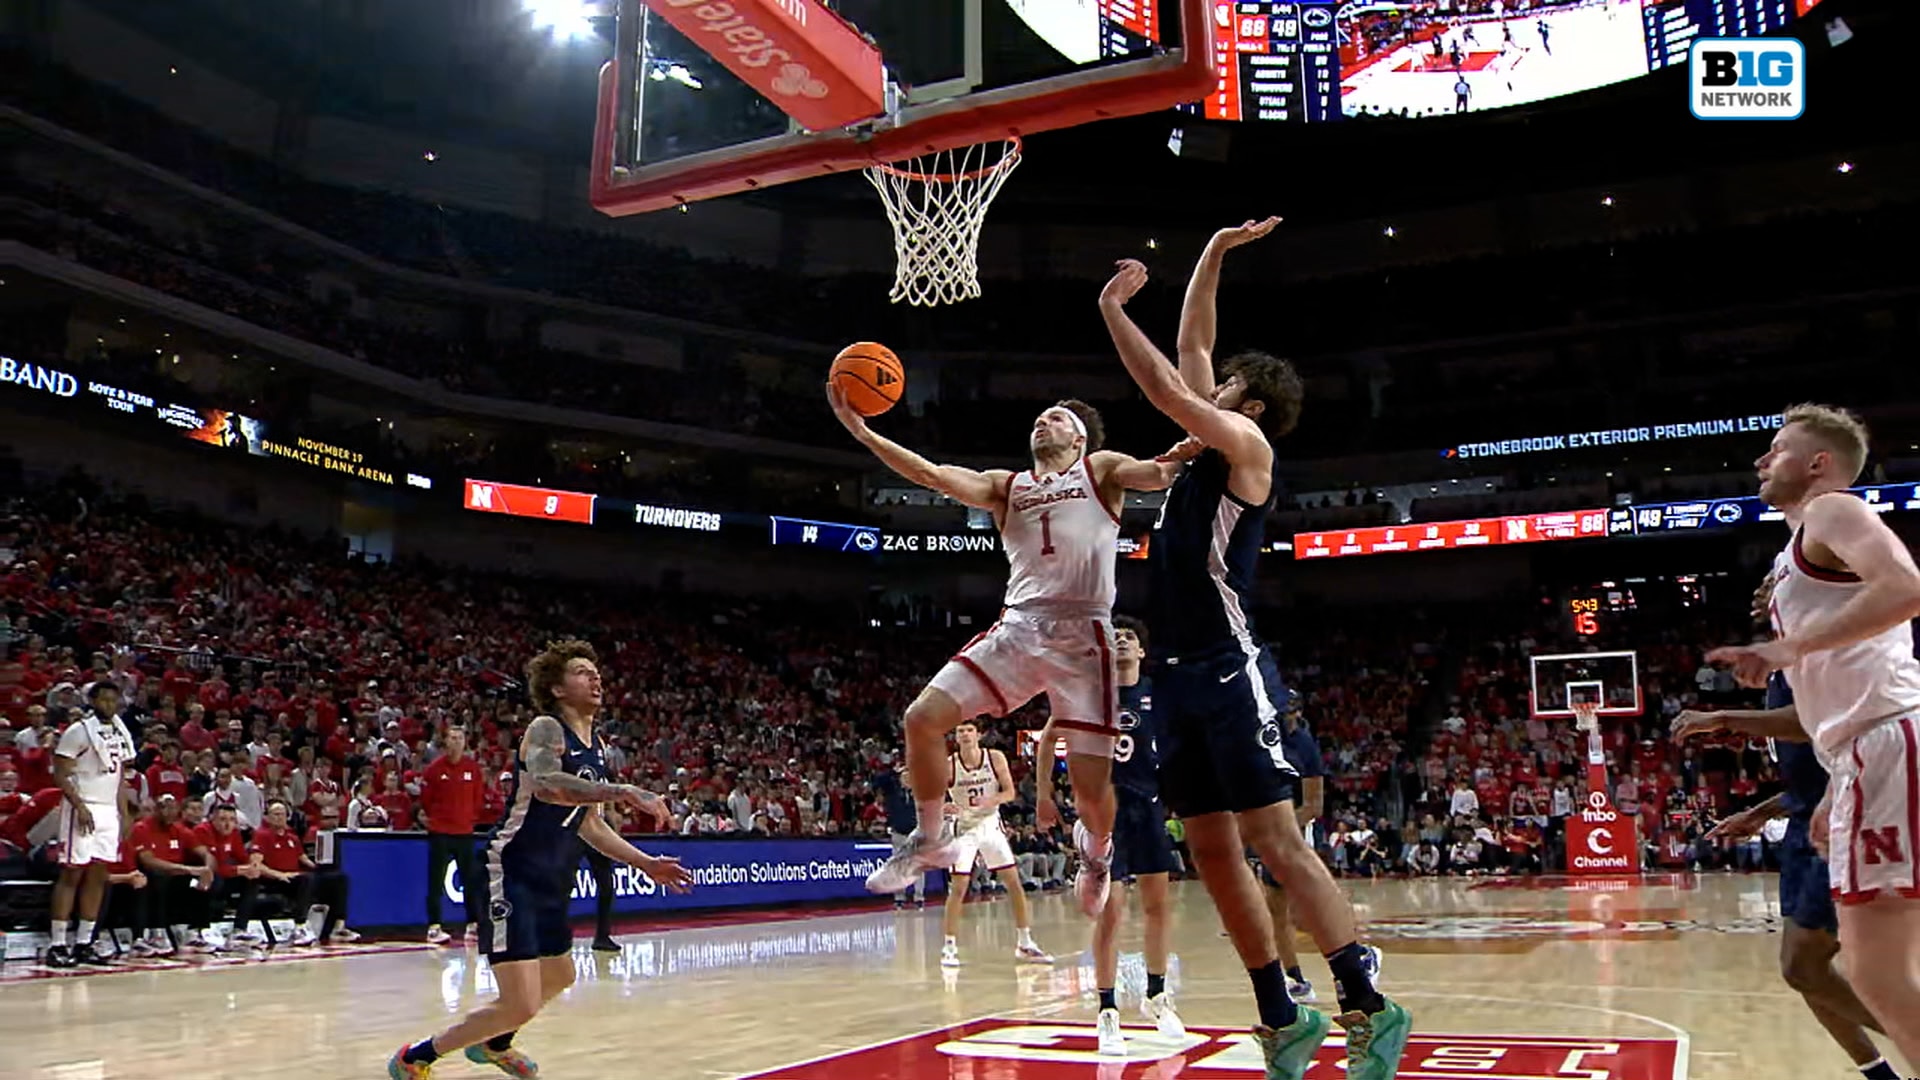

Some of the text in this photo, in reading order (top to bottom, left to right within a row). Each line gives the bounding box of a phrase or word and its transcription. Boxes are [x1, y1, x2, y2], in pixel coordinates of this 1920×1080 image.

[0, 357, 77, 397] BAND
[88, 381, 116, 397] LOVE
[107, 398, 135, 413] TOUR
[298, 437, 364, 464] NOVEMBER 19
[1458, 435, 1566, 459] STONEBROOK
[1570, 427, 1651, 449] EXTERIOR
[1655, 419, 1734, 441] PREMIUM
[262, 440, 320, 466] PINNACLE
[324, 457, 354, 475] BANK
[358, 466, 394, 485] ARENA
[635, 504, 721, 531] TURNOVERS
[802, 525, 818, 543] 14
[883, 535, 995, 552] ZAC BROWN
[1040, 511, 1055, 555] 1
[1571, 598, 1598, 613] 5:43
[1575, 613, 1599, 634] 15
[1114, 734, 1135, 762] 9
[1582, 808, 1616, 822] fnbo
[1860, 826, 1903, 864] N
[751, 859, 806, 883] Solutions
[809, 859, 850, 880] Crafted
[852, 858, 875, 877] with
[1573, 855, 1628, 868] Channel
